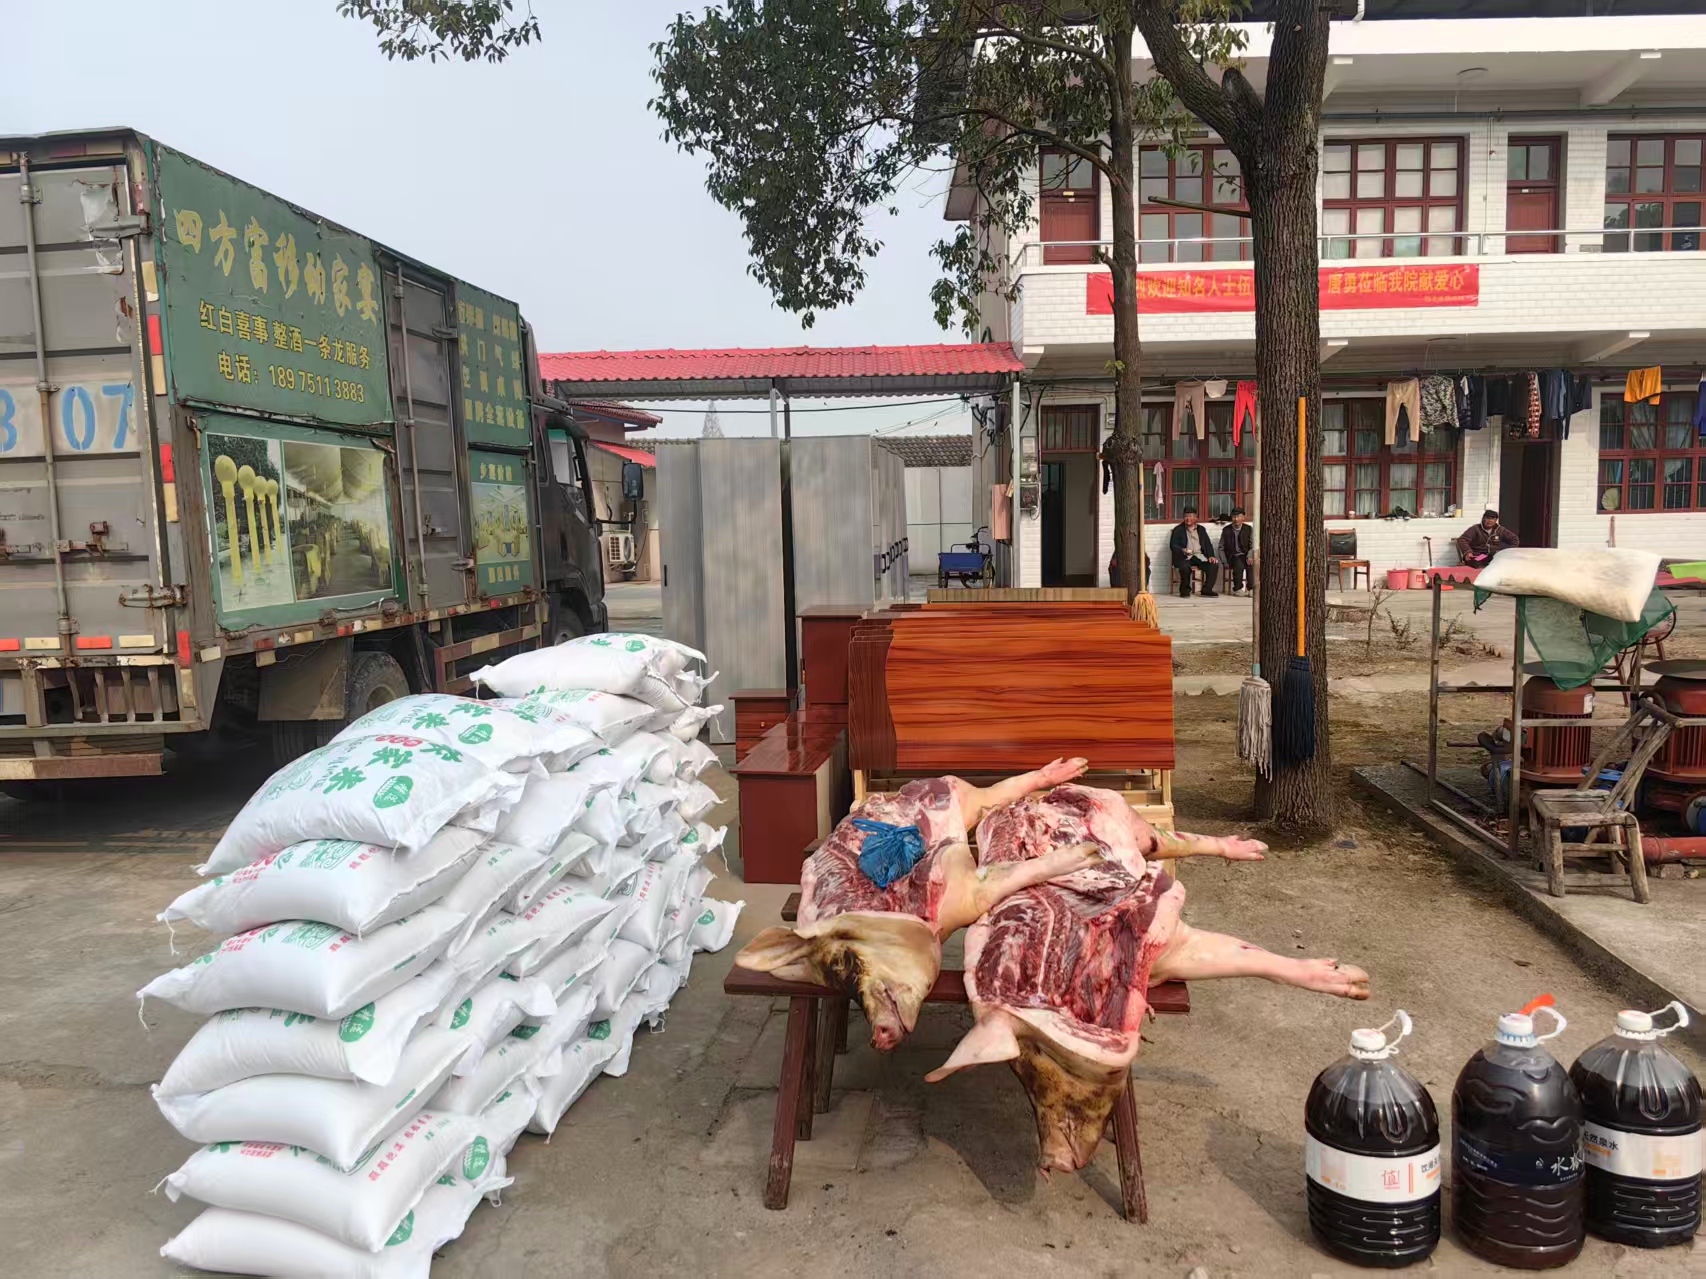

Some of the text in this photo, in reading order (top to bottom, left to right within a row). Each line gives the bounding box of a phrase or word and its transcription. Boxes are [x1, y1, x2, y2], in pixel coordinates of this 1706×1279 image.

[174, 209, 379, 327] 四方富移动家宴
[199, 299, 370, 370] 红白喜事 整酒一条龙服务
[268, 363, 296, 390] 189
[298, 371, 332, 397] 7511
[334, 379, 365, 402] 3883
